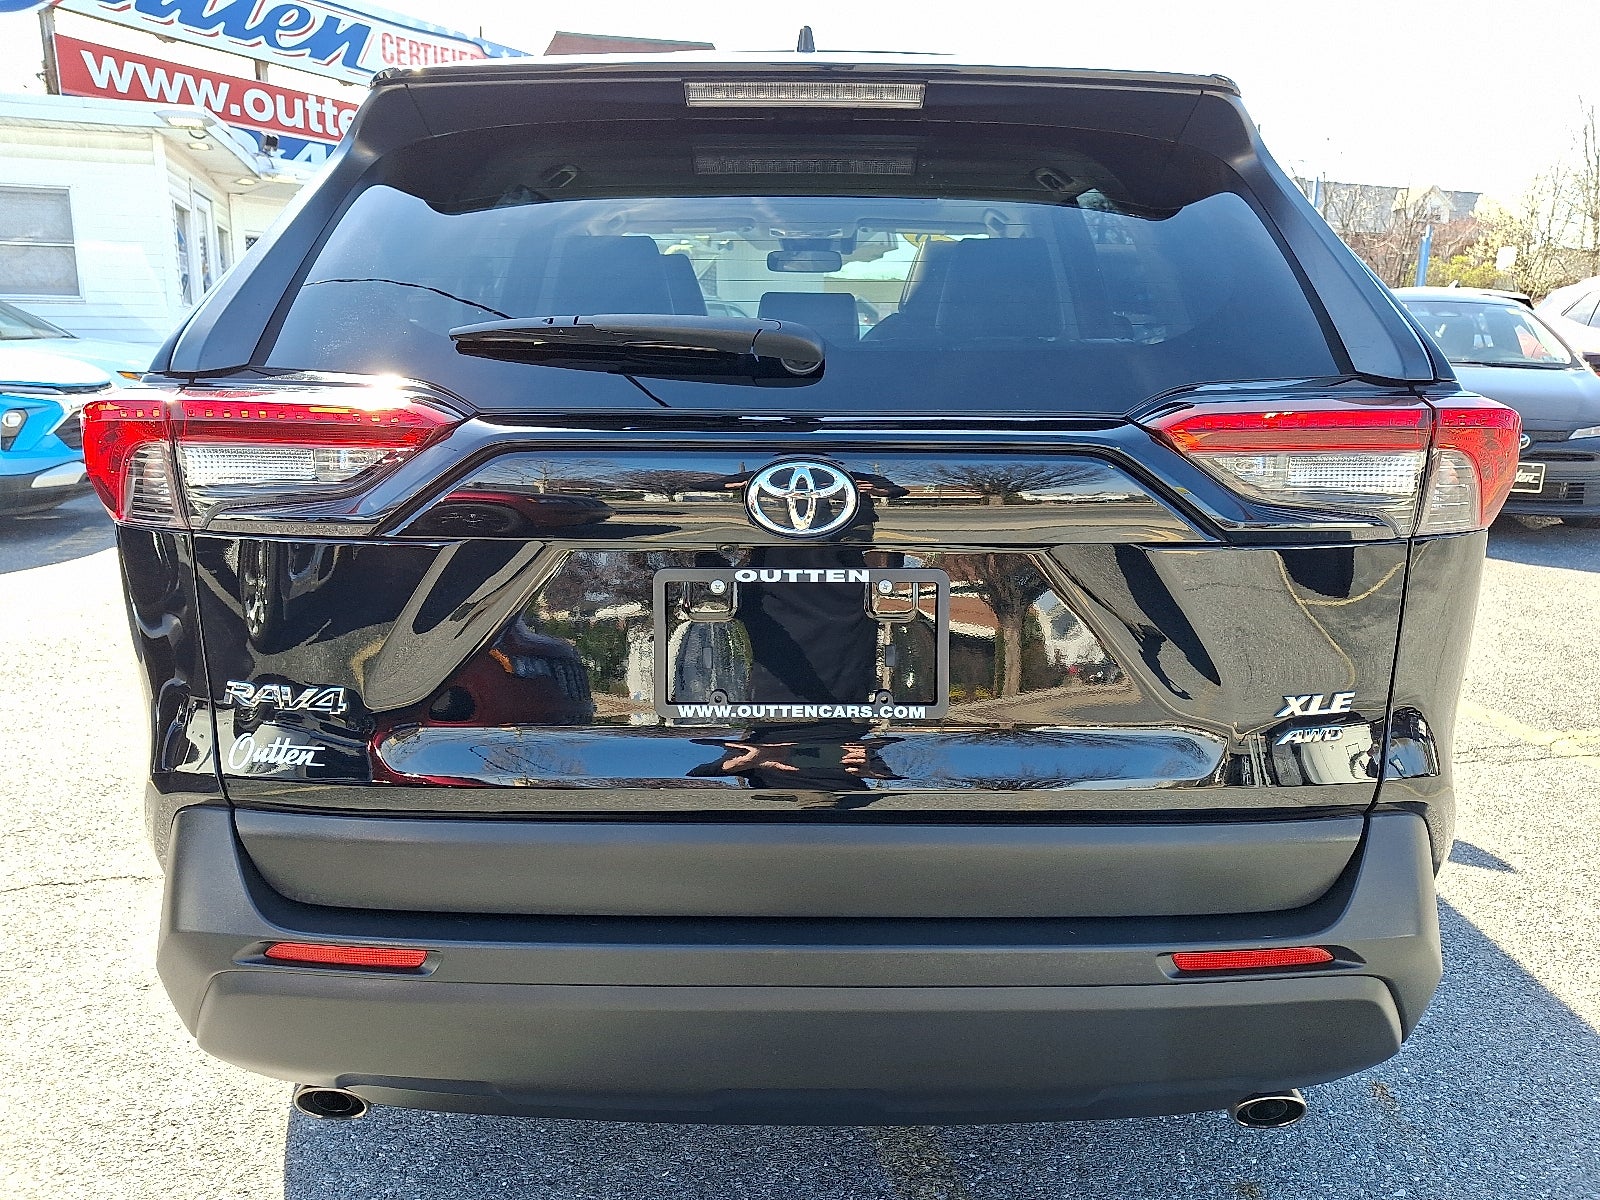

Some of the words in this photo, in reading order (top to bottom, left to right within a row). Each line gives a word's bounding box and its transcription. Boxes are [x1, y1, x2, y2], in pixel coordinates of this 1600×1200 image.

[381, 32, 478, 65] CERTIFI
[734, 569, 870, 583] OUTTEN
[224, 679, 349, 715] RAV4
[1274, 690, 1357, 718] XLE
[677, 704, 927, 719] WWW.OUTTENCARS.COM
[1275, 725, 1345, 746] AWD
[227, 732, 326, 770] Outten
